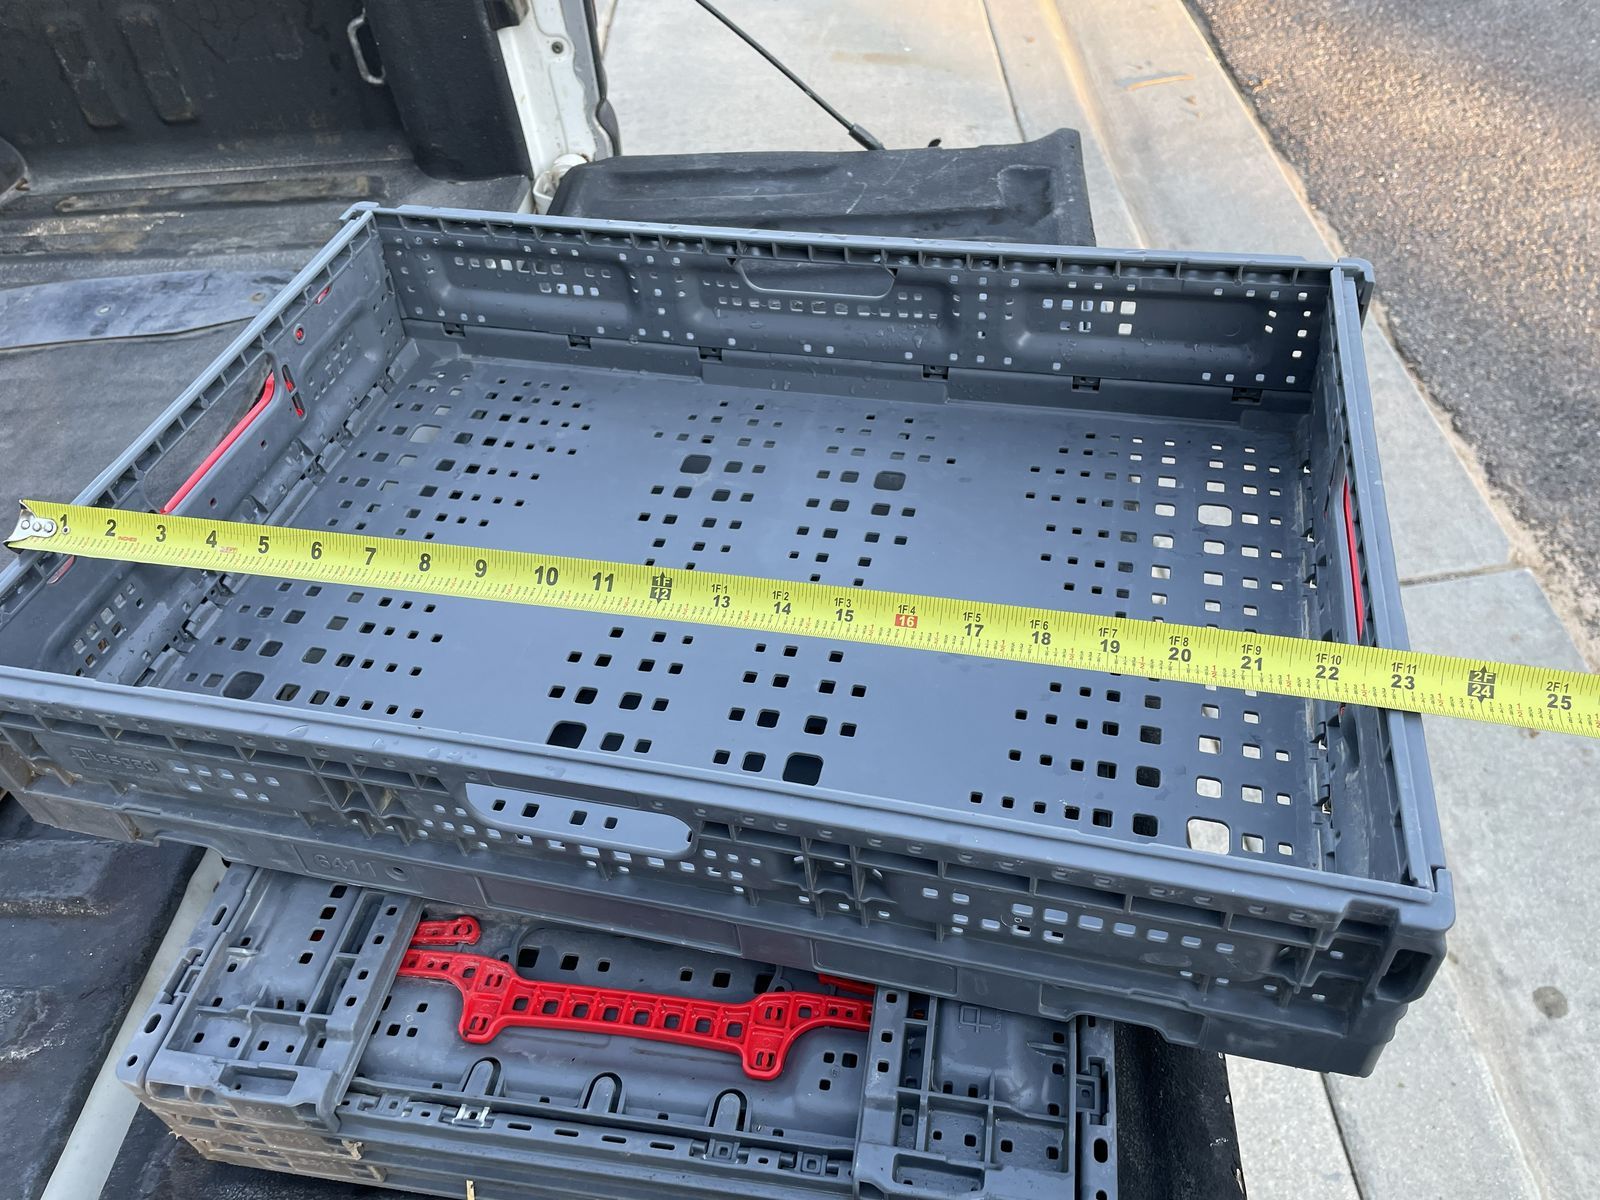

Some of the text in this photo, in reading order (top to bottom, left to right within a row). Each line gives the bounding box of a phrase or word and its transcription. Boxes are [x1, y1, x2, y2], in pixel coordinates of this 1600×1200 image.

[105, 519, 117, 537] 2
[156, 525, 167, 543] 3
[206, 530, 217, 548] 4
[258, 536, 270, 554] 5
[311, 542, 322, 560] 6
[365, 547, 377, 565] 7
[419, 553, 431, 571] 8
[475, 559, 487, 577] 9
[534, 565, 559, 586] 10
[592, 572, 614, 592] 11
[654, 588, 669, 600] 12
[713, 595, 731, 608] 13
[773, 602, 792, 615] 14
[835, 608, 854, 622] 15
[898, 616, 915, 627] 16
[964, 623, 984, 637] 17
[1031, 631, 1052, 645] 18
[1100, 639, 1121, 654] 19
[1168, 647, 1192, 662] 20
[1240, 655, 1263, 671] 21
[1315, 665, 1339, 681] 22
[1391, 674, 1415, 690] 23
[1471, 685, 1491, 698] 24
[1547, 694, 1572, 710] 25
[313, 854, 377, 878] 6411
